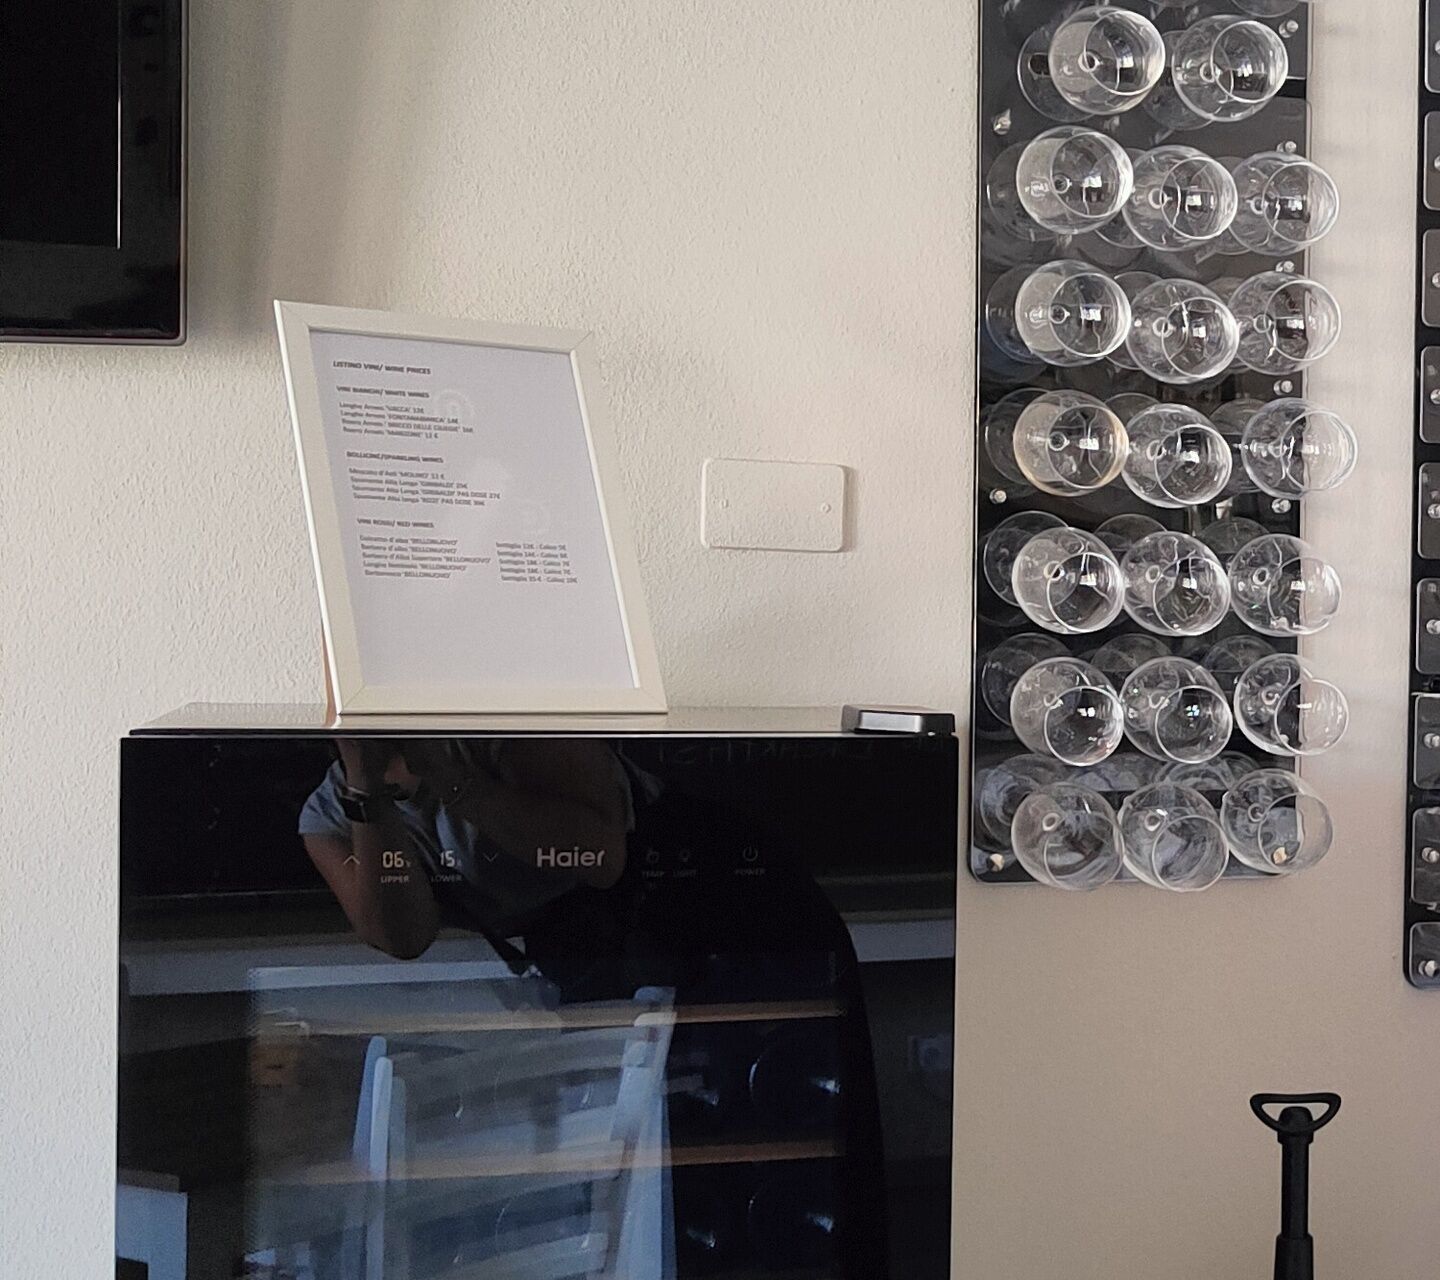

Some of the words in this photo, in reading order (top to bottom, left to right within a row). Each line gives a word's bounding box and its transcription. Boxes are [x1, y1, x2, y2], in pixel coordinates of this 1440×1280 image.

[382, 850, 405, 869] 06
[439, 849, 456, 868] 15
[537, 847, 605, 869] Haier
[380, 874, 410, 884] UPPER
